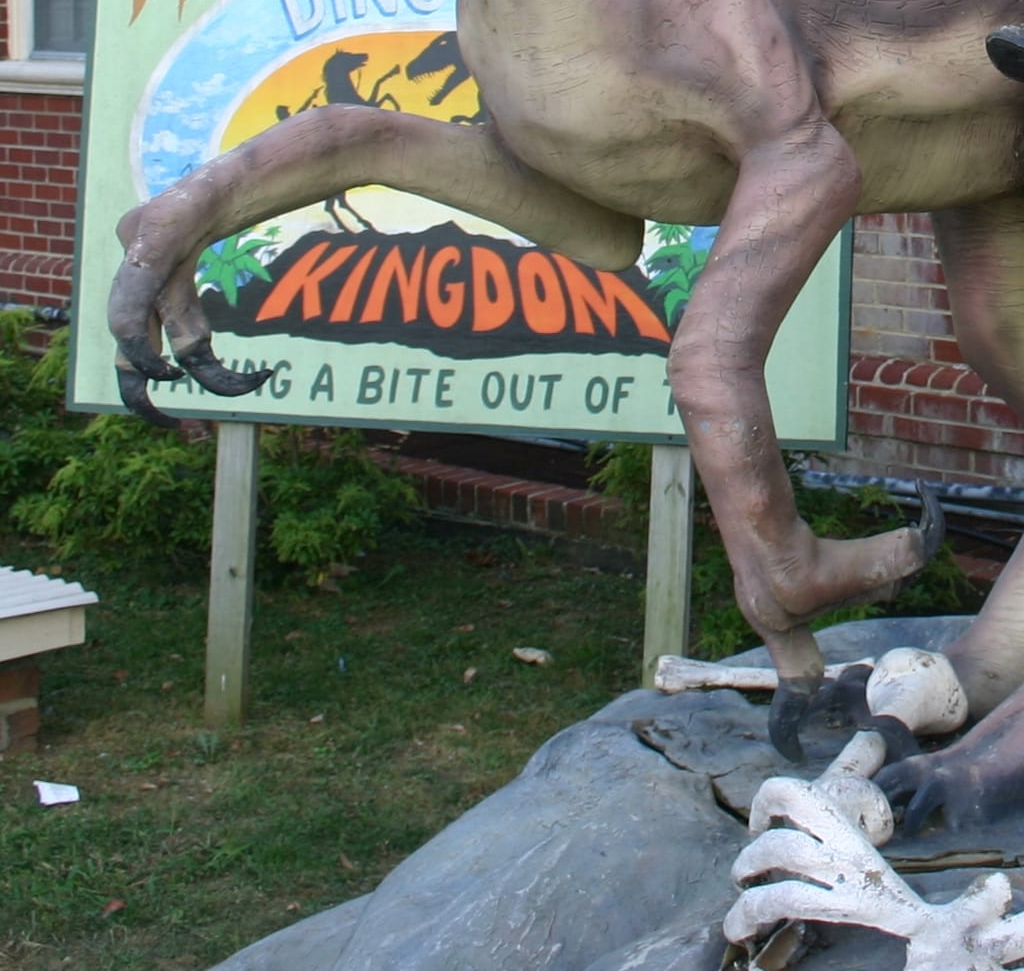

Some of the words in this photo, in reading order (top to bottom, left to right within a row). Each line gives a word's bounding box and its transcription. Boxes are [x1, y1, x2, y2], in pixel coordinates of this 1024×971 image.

[256, 241, 671, 344] KINGDOM
[310, 363, 334, 402] A
[356, 365, 456, 408] BITE
[481, 371, 563, 411] OUT
[584, 376, 635, 414] OF
